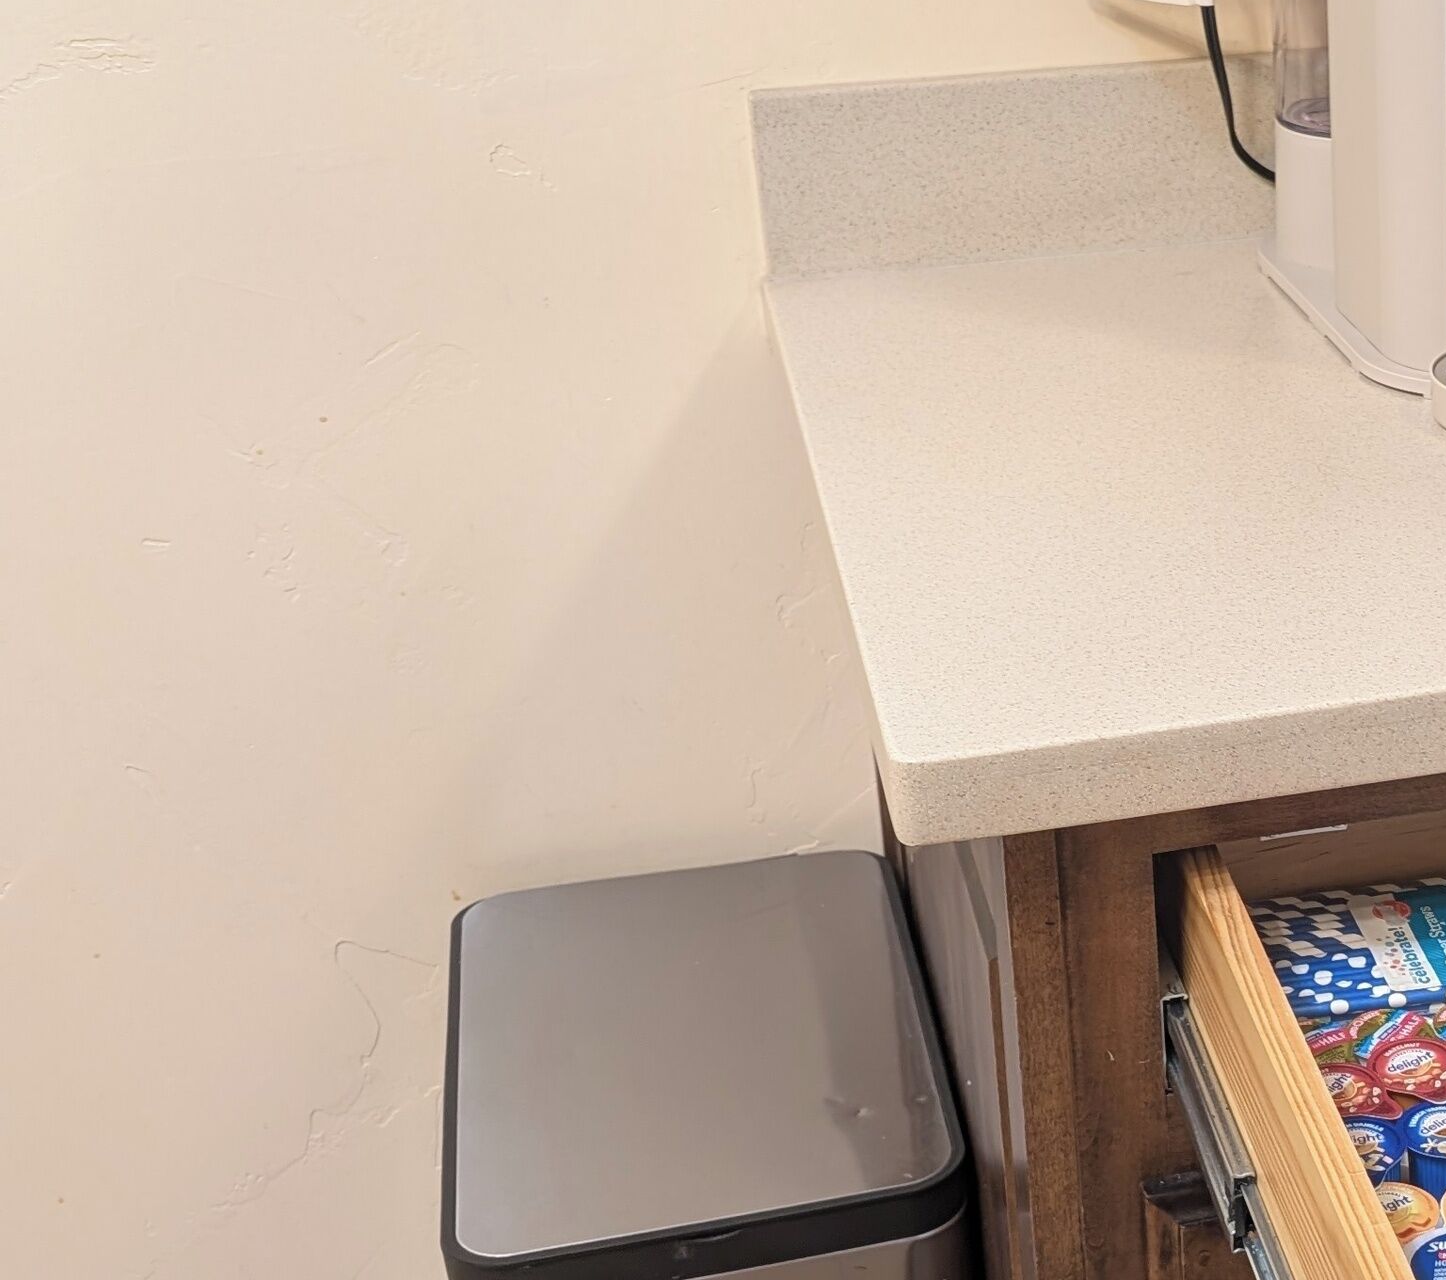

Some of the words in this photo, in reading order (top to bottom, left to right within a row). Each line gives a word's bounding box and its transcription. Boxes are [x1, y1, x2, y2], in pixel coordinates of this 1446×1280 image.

[1420, 906, 1445, 938] Straws
[1388, 927, 1431, 985] celebrate!
[1319, 1032, 1345, 1046] HALF
[1388, 1051, 1434, 1074] delight
